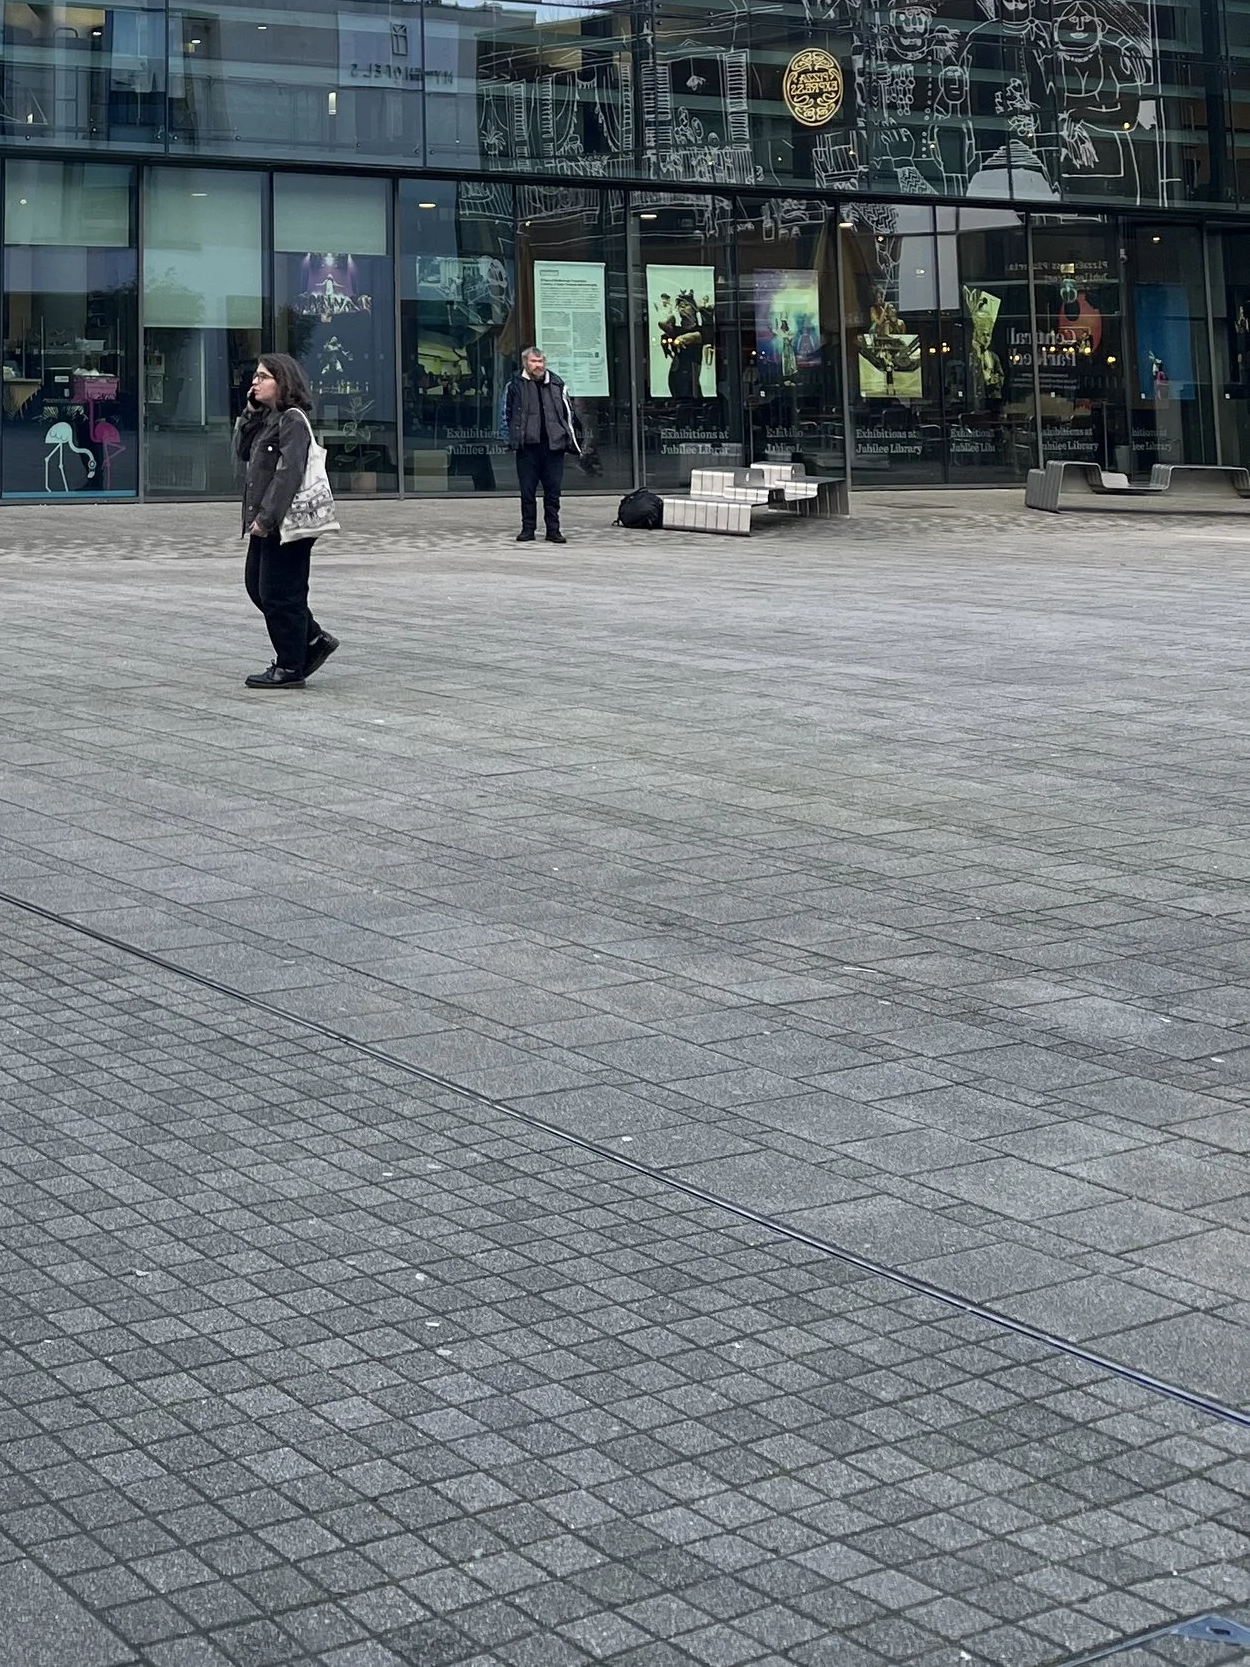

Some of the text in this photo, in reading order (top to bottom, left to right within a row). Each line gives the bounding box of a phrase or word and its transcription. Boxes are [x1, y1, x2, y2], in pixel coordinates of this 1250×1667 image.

[446, 428, 502, 439] Exhibition
[661, 429, 729, 439] Exhibitions at
[856, 428, 918, 439] Exhibitions at
[447, 444, 508, 454] Jubilee Libr
[661, 444, 730, 455] Jubilee Librar
[856, 443, 922, 455] Jubilee Library
[1068, 441, 1099, 452] Library
